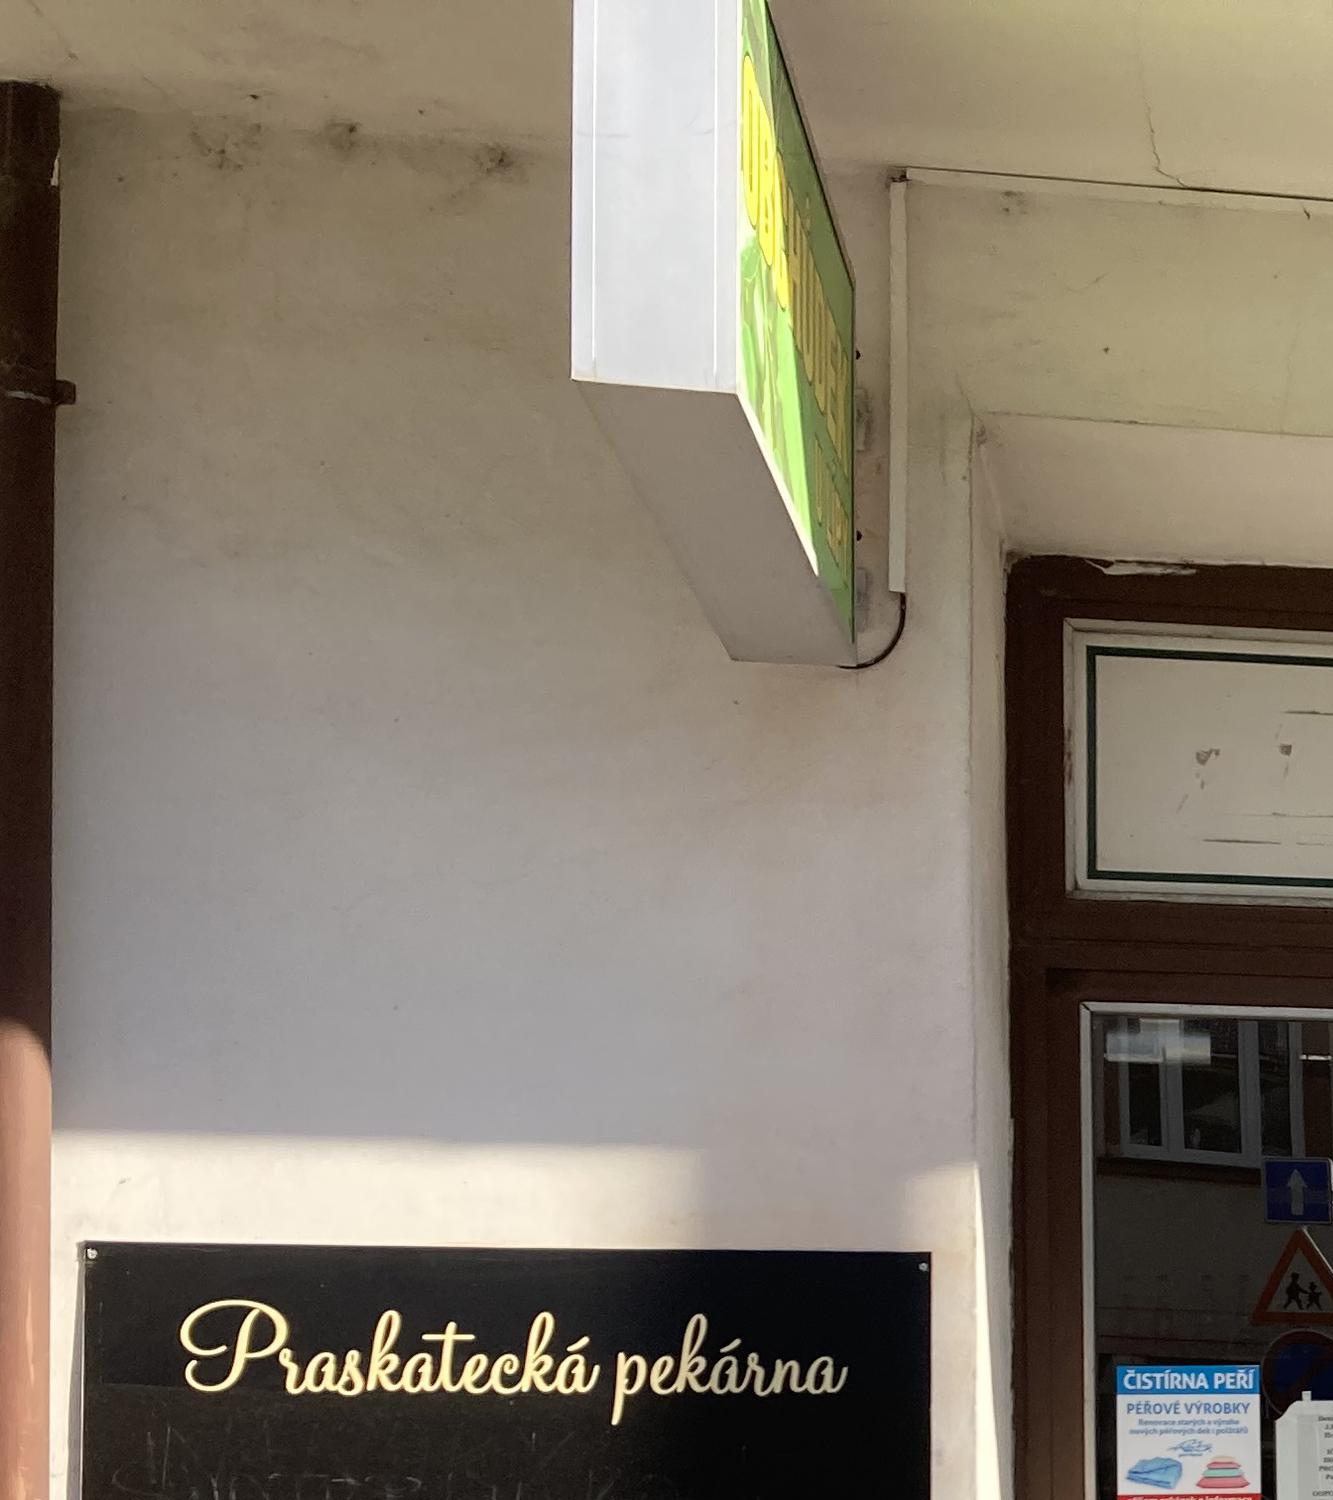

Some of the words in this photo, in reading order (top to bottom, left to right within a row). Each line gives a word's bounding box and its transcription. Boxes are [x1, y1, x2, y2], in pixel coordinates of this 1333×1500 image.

[179, 1299, 599, 1394] Praskatecká
[613, 1313, 848, 1426] pekárna
[1123, 1368, 1209, 1390] ČISTÍRNA
[1214, 1366, 1256, 1389] PEŘÍ
[1127, 1400, 1181, 1414] PÉŘOVÉ
[1184, 1400, 1250, 1414] VÝROBKY
